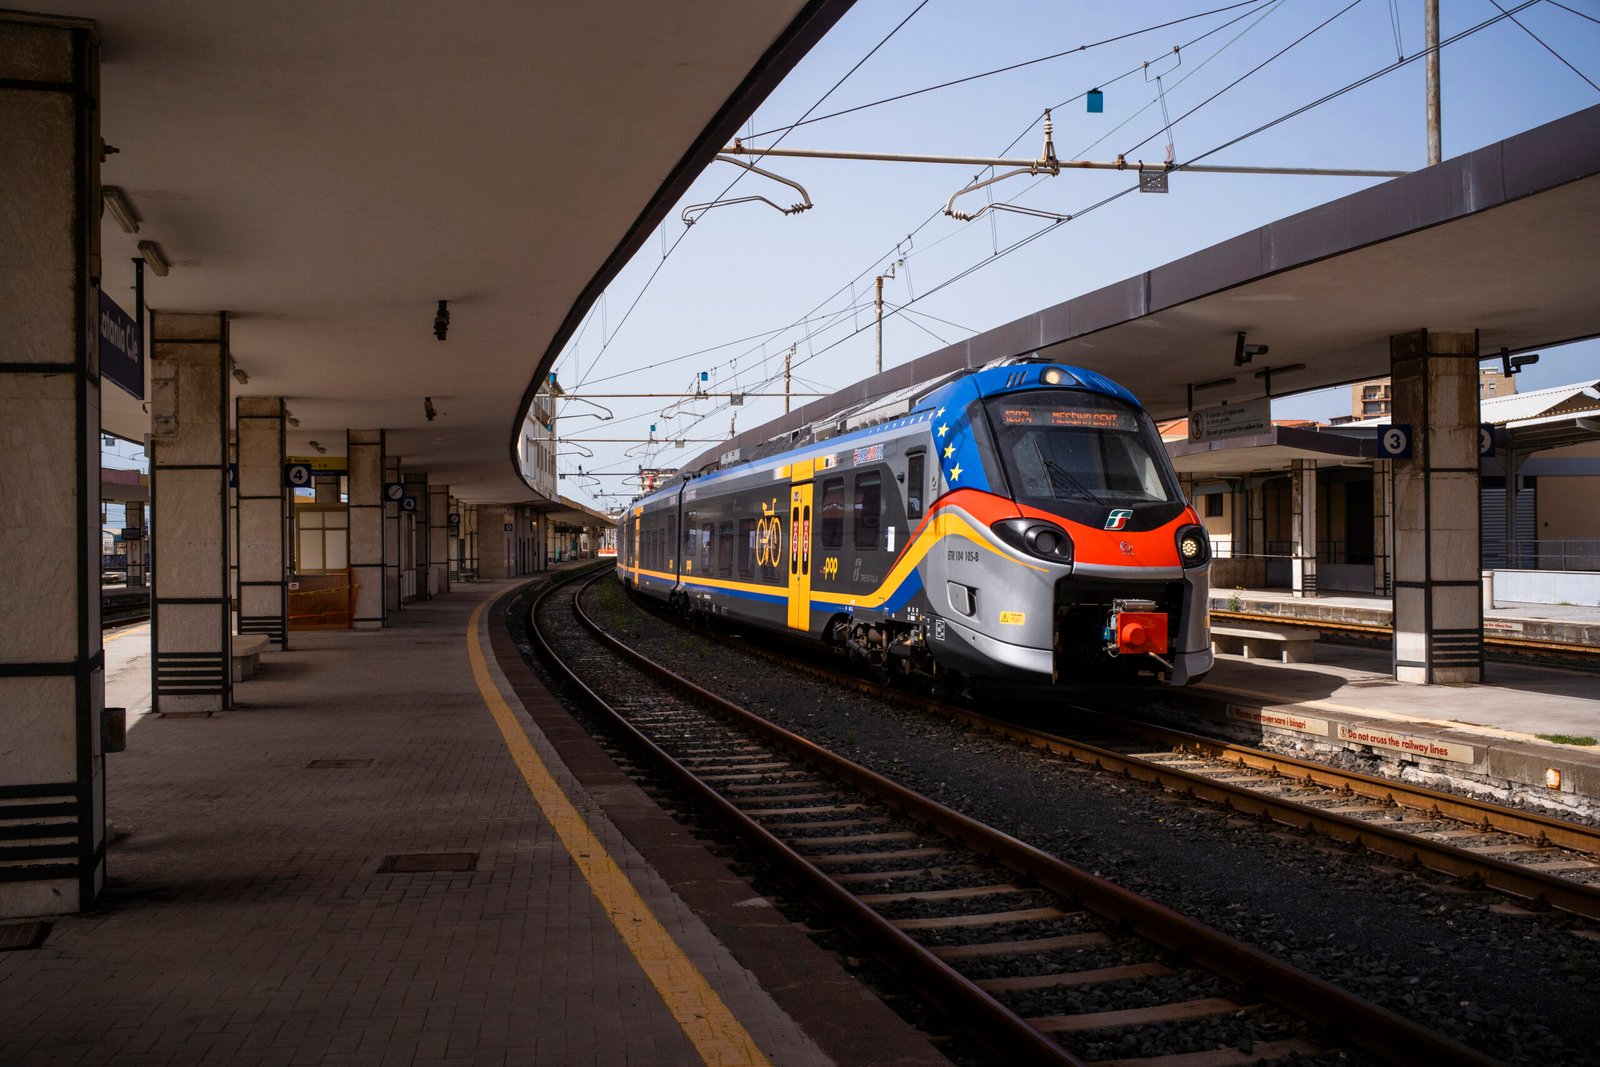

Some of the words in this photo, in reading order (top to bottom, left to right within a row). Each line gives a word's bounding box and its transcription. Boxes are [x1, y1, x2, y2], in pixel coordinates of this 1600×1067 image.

[101, 310, 126, 352] atania
[1390, 434, 1400, 449] 3
[293, 470, 303, 480] 4
[965, 551, 979, 562] 105-B
[824, 557, 838, 580] pop
[1253, 713, 1286, 726] attraversare
[1290, 718, 1306, 729] binari
[1347, 729, 1357, 740] Do
[1358, 732, 1369, 741] not
[1370, 735, 1387, 745] cross
[1388, 736, 1399, 747] the
[1401, 740, 1428, 755] railway
[1430, 743, 1448, 757] lines
